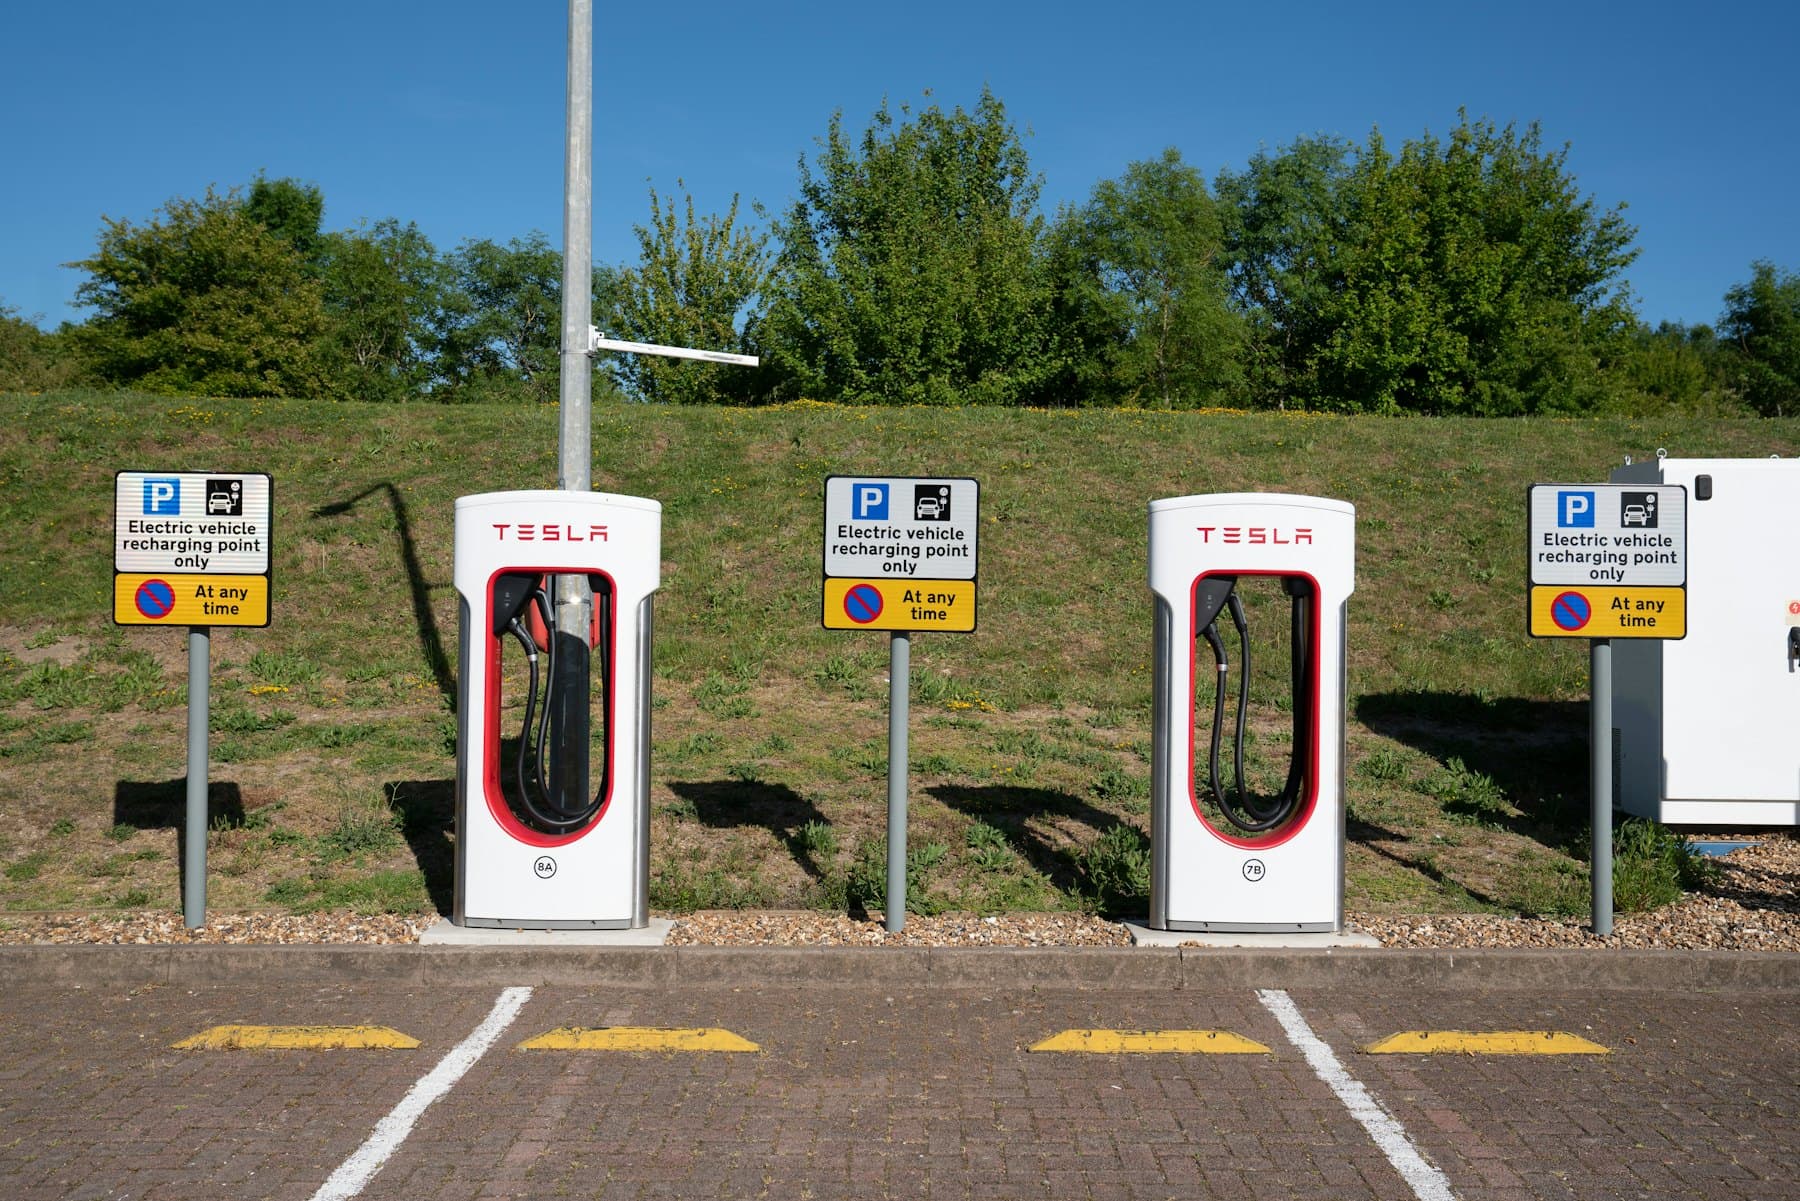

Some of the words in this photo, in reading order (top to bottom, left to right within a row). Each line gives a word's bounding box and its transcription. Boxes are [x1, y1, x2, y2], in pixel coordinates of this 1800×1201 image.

[151, 483, 174, 512] P
[860, 487, 883, 516] P
[1566, 495, 1589, 524] P
[129, 520, 193, 534] Electric
[199, 521, 256, 535] vehicle
[492, 524, 608, 542] TESLA
[838, 525, 901, 539] Electric
[907, 527, 965, 540] vehicle
[1196, 527, 1313, 545] TESLA
[1544, 533, 1608, 546] Electric
[1613, 533, 1672, 547] vehicle
[123, 538, 212, 553] recharging
[218, 539, 261, 553] point
[832, 542, 920, 558] recharging
[926, 544, 969, 559] point
[174, 555, 209, 570] only
[1538, 550, 1628, 565] recharging
[1634, 551, 1677, 566] point
[882, 559, 917, 575] only
[1589, 567, 1625, 582] only
[195, 585, 214, 598] At
[219, 588, 248, 601] any
[903, 590, 922, 603] At
[927, 593, 956, 606] any
[203, 602, 239, 615] time
[1611, 597, 1630, 610] At
[1635, 600, 1665, 613] any
[911, 607, 947, 620] time
[1619, 614, 1656, 627] time
[538, 862, 553, 872] 8A
[1247, 865, 1262, 875] 7B
